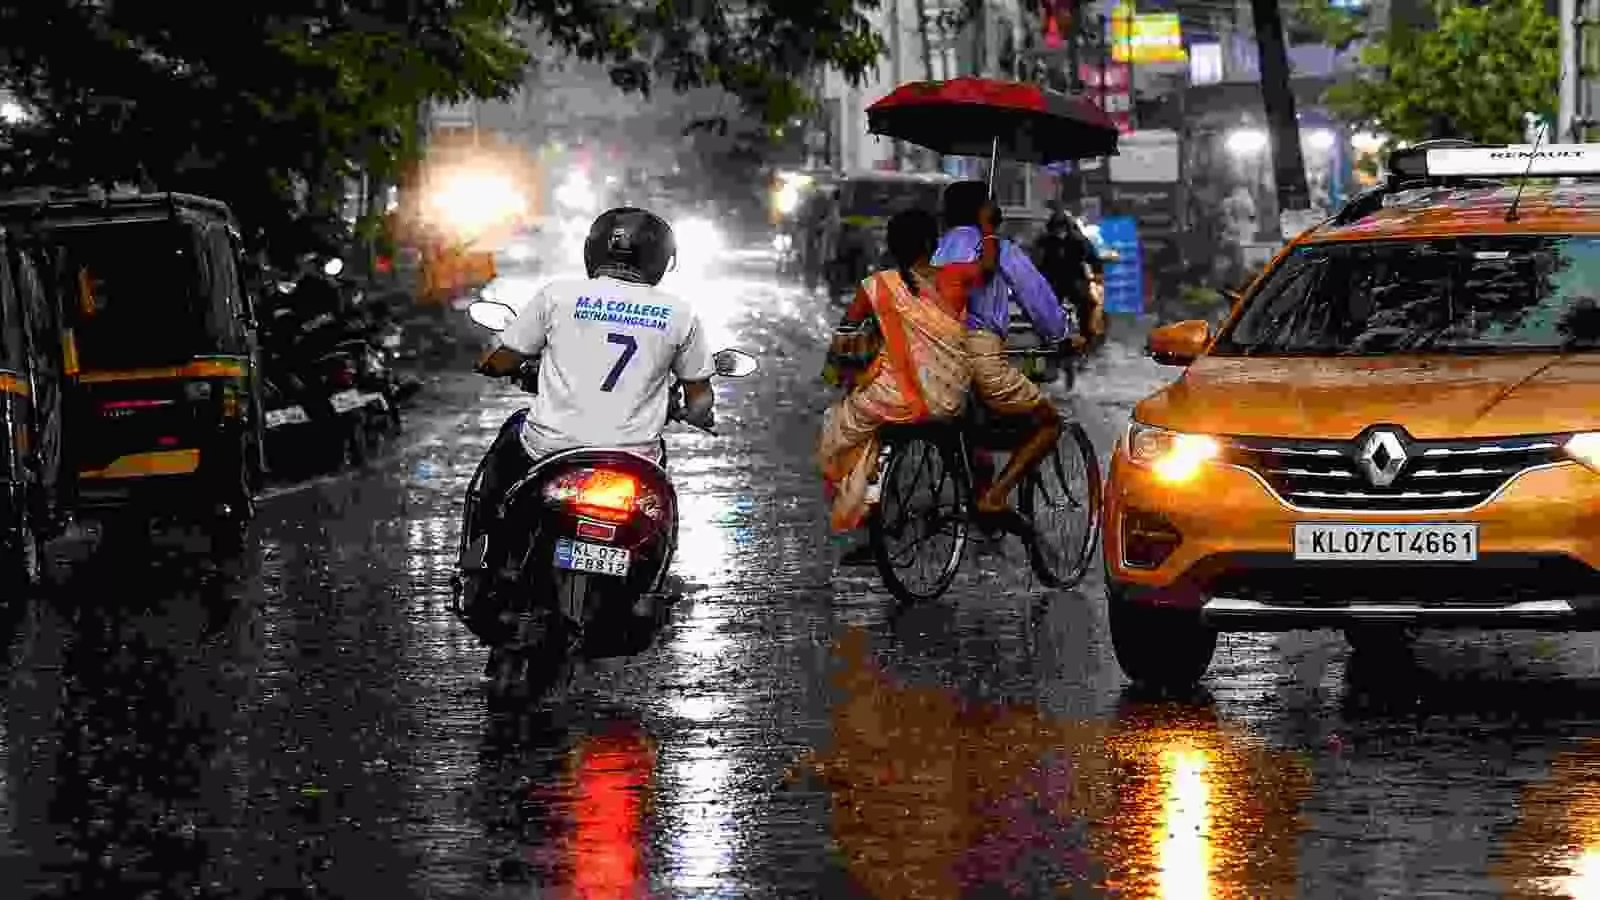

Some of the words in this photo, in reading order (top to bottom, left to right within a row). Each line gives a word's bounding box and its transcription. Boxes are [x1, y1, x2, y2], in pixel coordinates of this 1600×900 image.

[1490, 150, 1586, 160] RENAULT
[606, 300, 672, 319] COLLEGE
[600, 333, 638, 392] 7
[573, 542, 593, 557] KL
[1311, 531, 1473, 554] KL07CT4661
